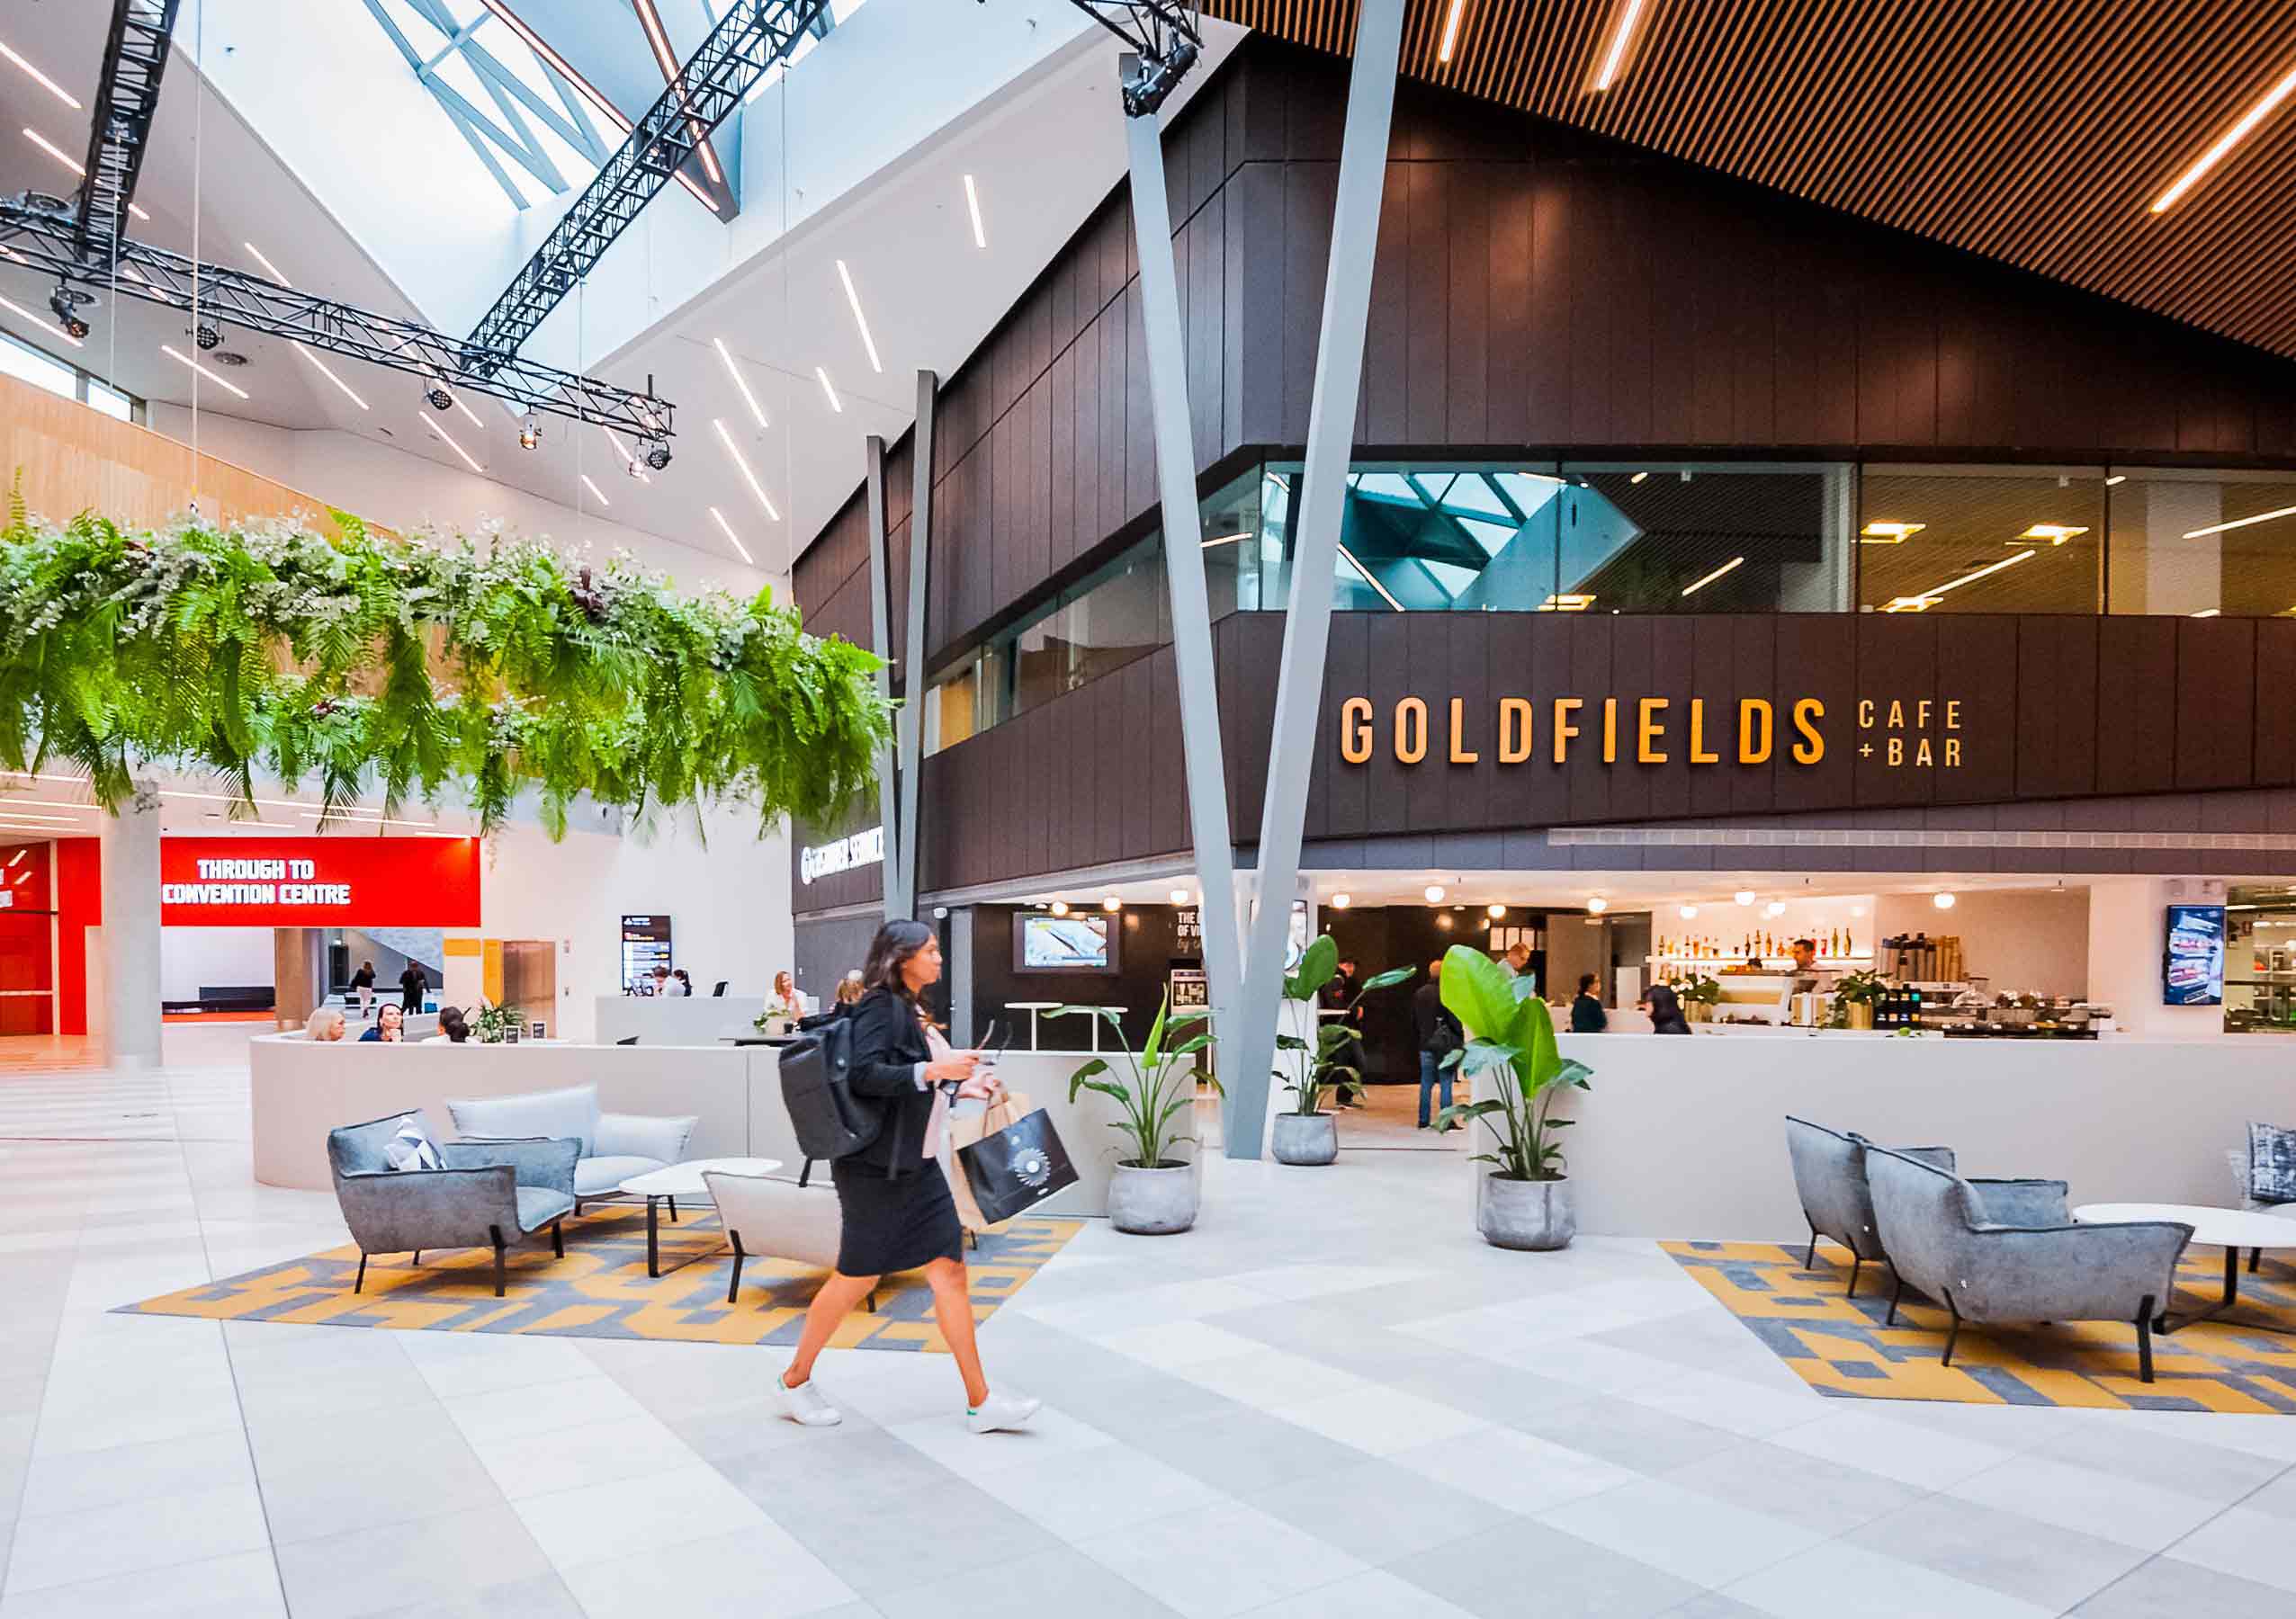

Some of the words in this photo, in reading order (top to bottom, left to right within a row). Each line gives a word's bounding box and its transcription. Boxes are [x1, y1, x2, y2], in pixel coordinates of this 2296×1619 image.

[1859, 700, 1960, 729] CAFE
[1341, 697, 1825, 765] GOLDFIELDS
[197, 860, 285, 879] THROUGH
[288, 860, 314, 879] TO
[162, 884, 275, 904] CONVENTION
[279, 884, 351, 904] CENTRE
[1178, 912, 1196, 924] THE
[1178, 925, 1189, 936] OF
